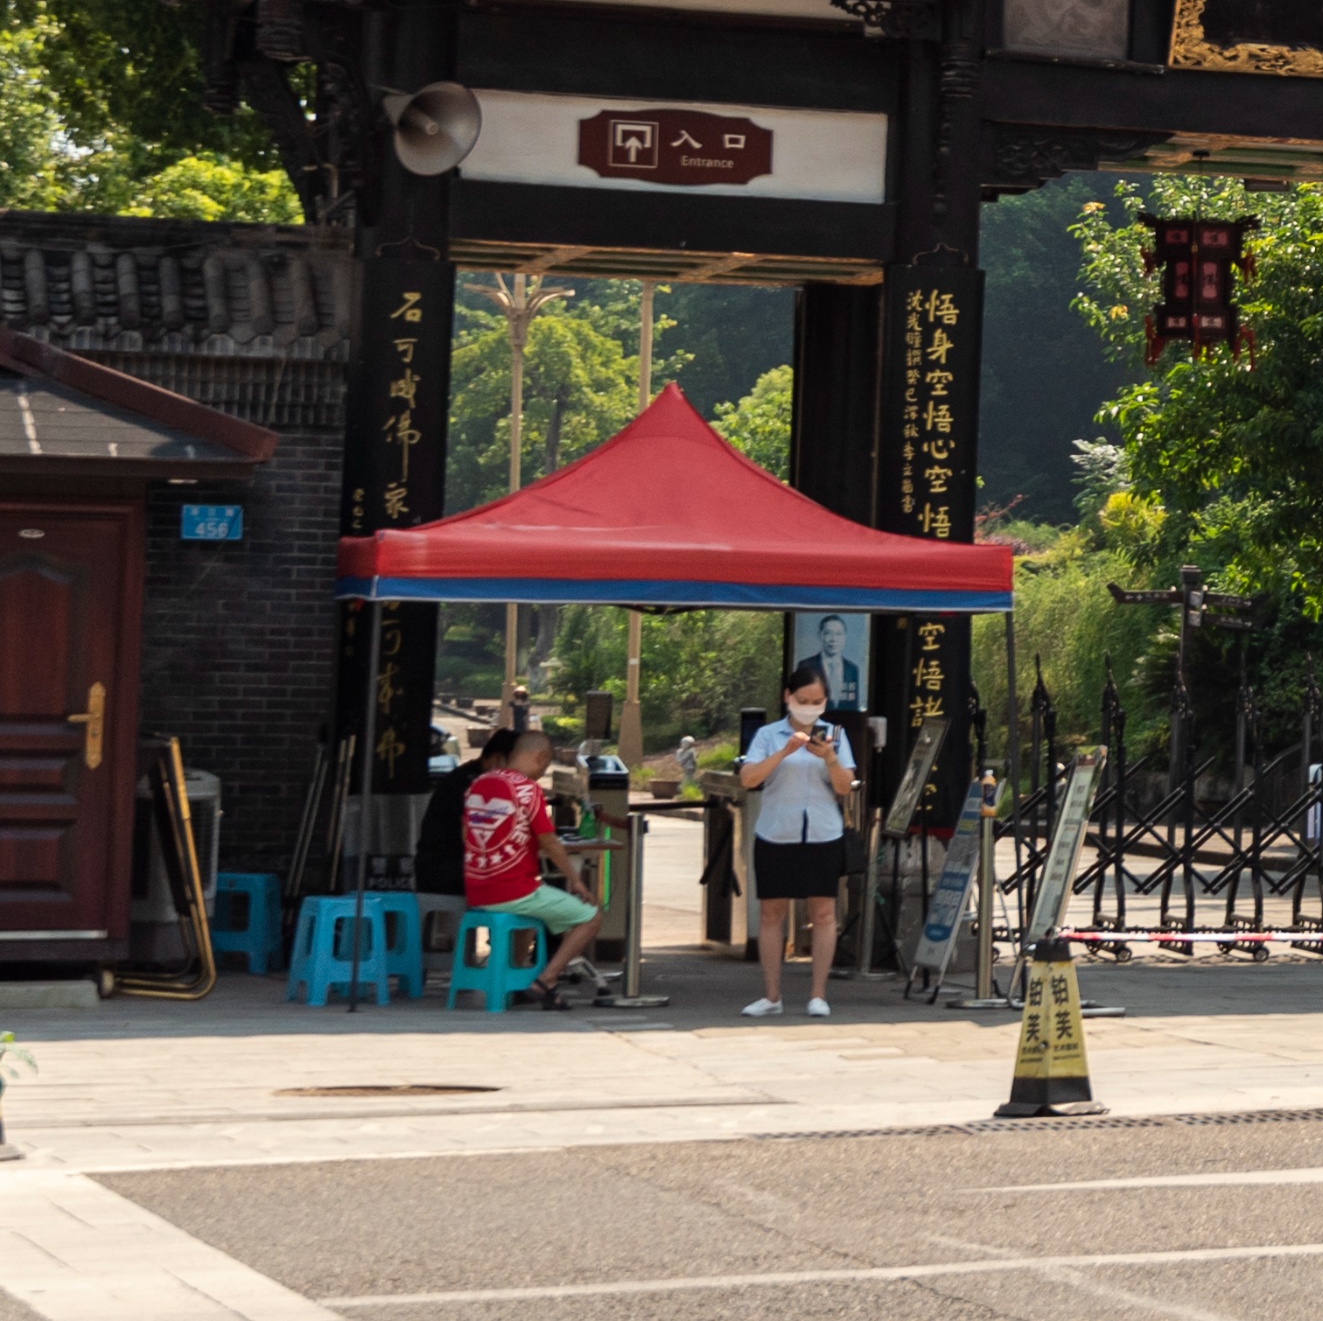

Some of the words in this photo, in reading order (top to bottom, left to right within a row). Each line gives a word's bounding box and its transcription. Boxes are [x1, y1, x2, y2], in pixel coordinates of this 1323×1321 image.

[671, 130, 746, 150] 入口
[680, 155, 735, 169] Entrance
[1051, 974, 1073, 1040] 铂芙
